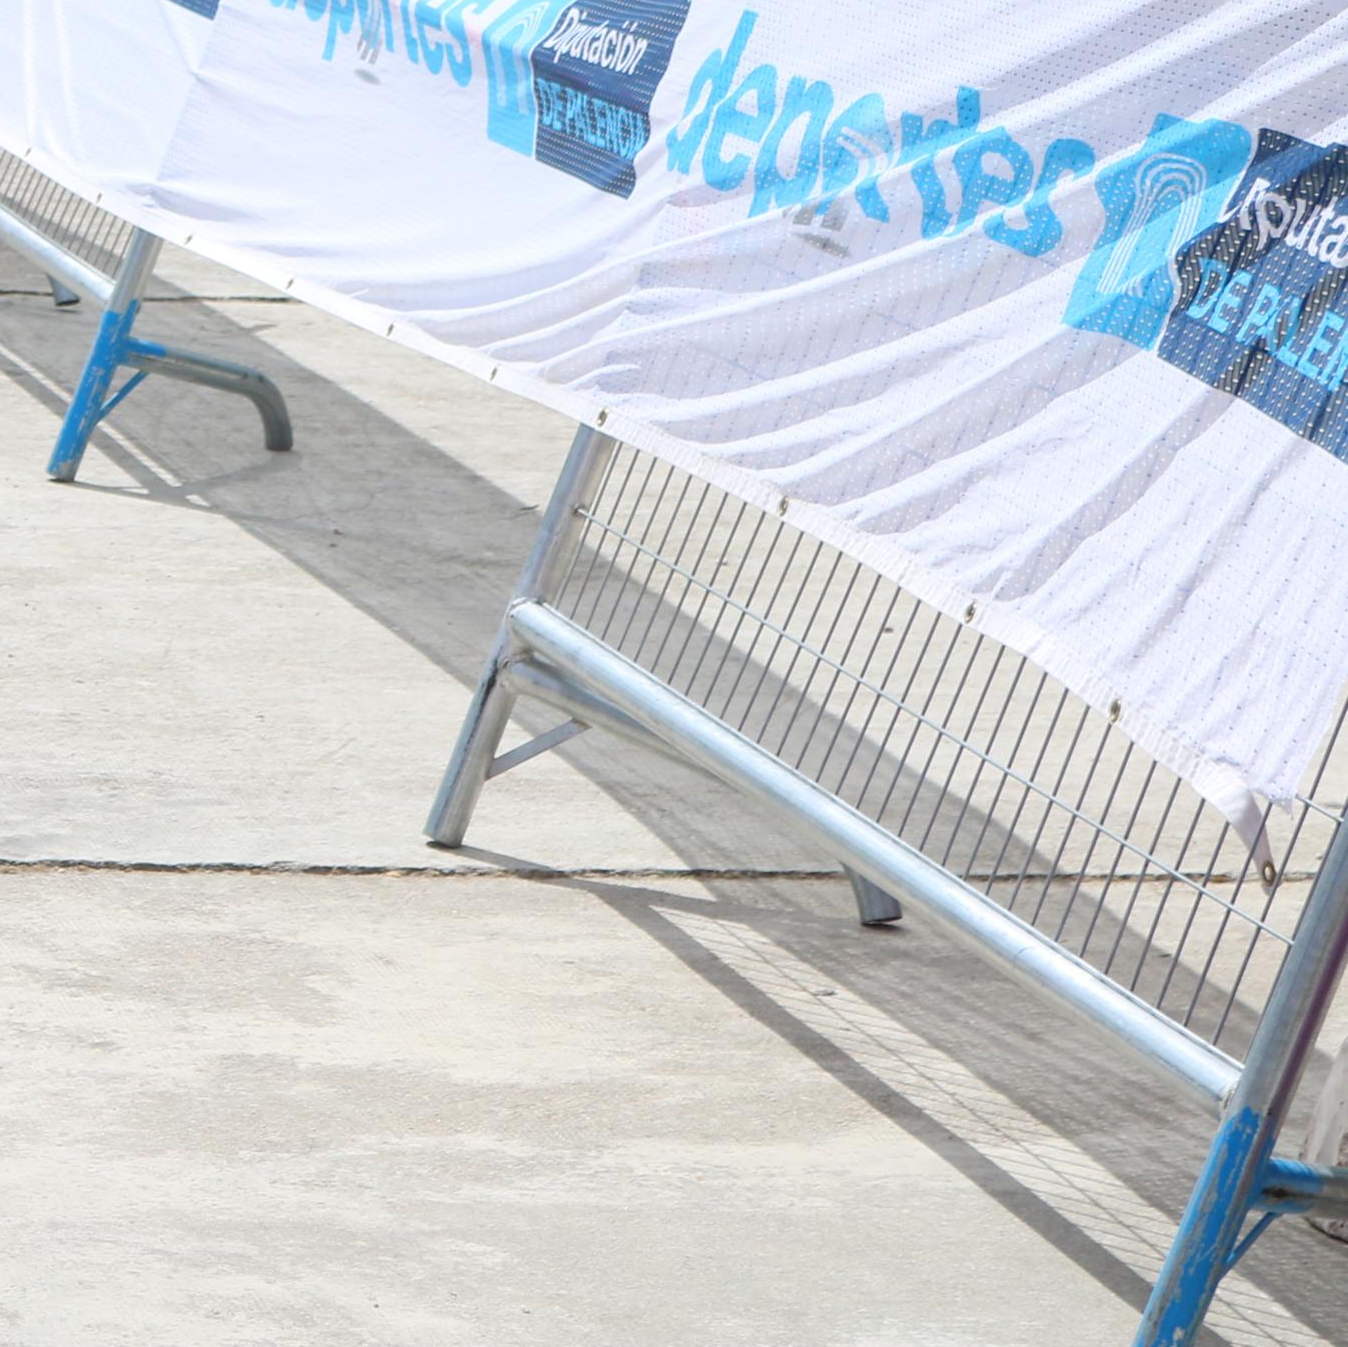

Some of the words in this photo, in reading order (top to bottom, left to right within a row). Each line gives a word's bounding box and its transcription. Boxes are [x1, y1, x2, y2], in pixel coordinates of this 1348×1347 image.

[543, 7, 650, 76] Diputación
[536, 77, 563, 132] DE
[666, 9, 1096, 258] deportes
[1185, 256, 1253, 335] DE
